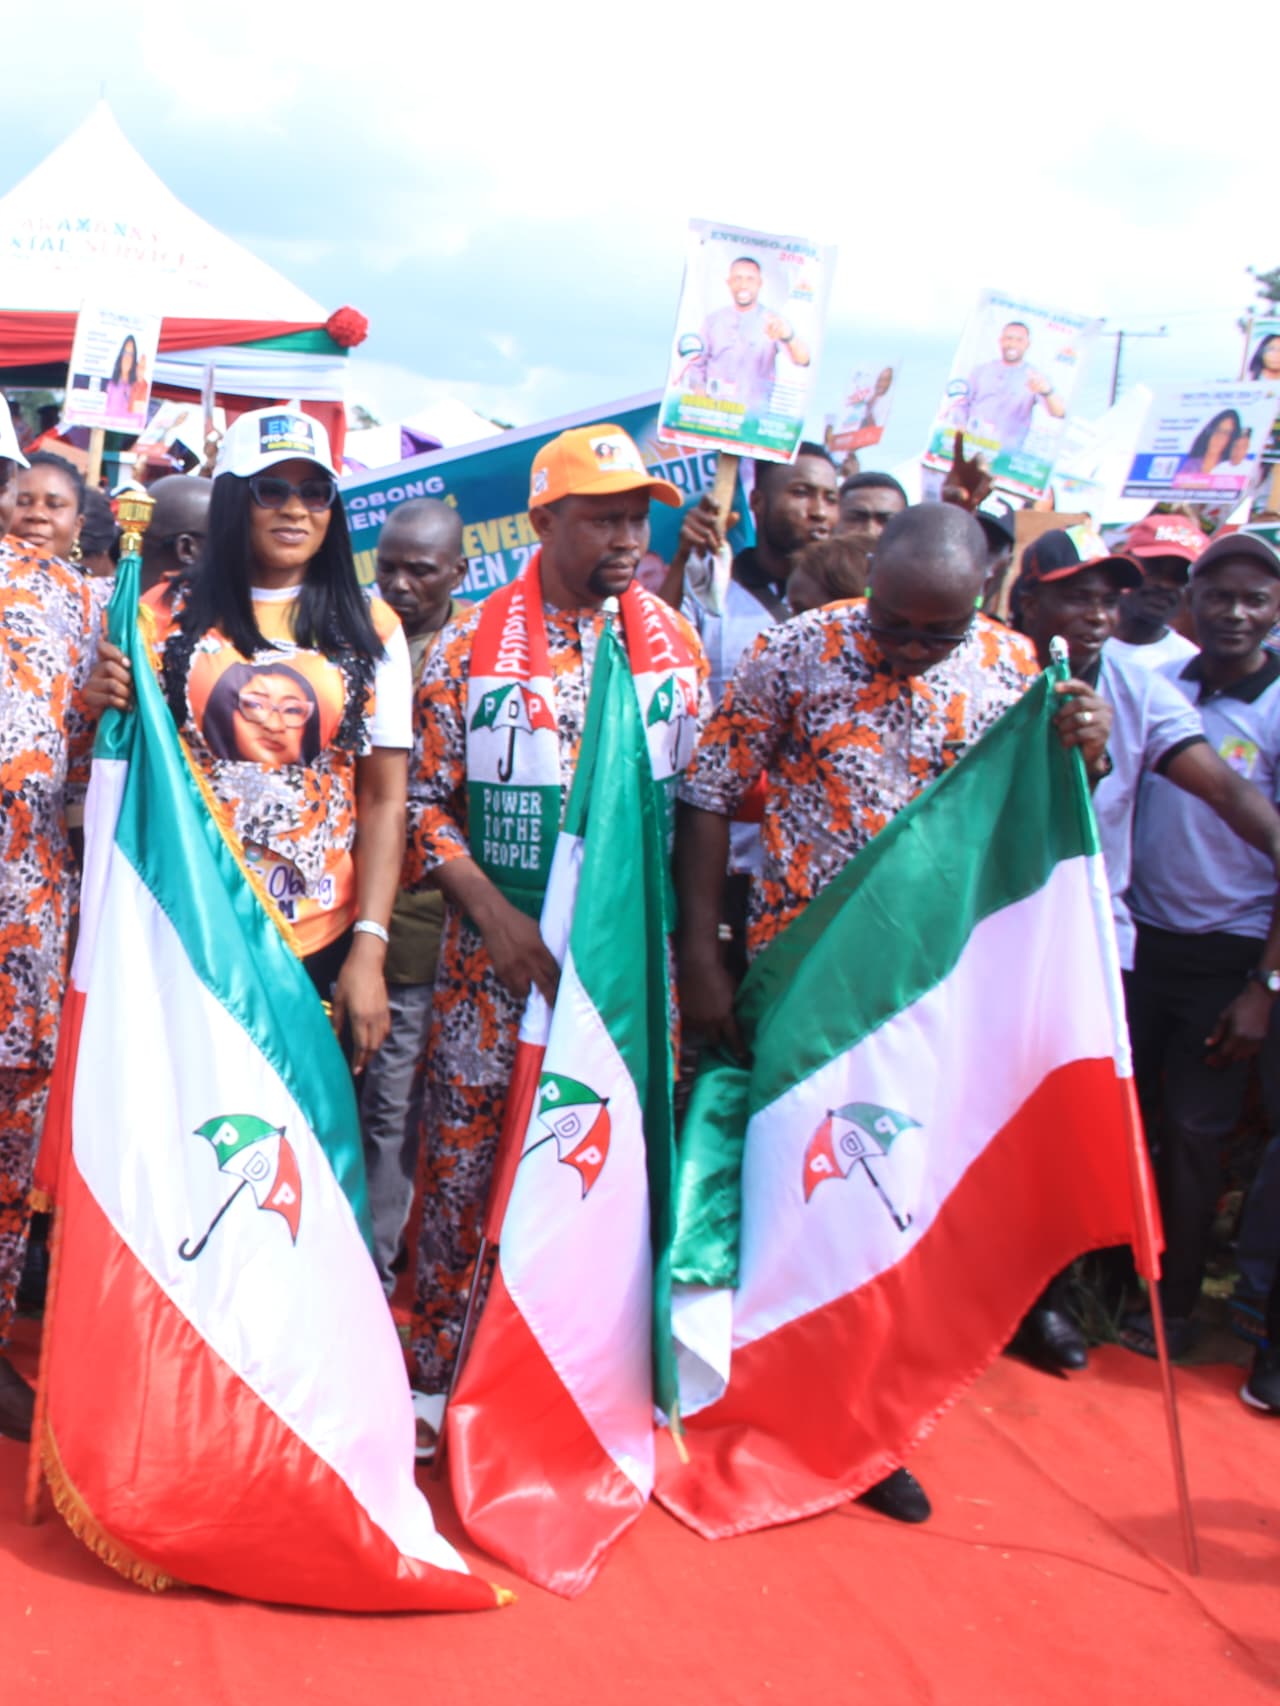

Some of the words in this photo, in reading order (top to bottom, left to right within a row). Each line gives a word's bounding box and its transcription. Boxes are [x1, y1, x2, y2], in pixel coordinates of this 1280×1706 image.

[484, 697, 543, 720] PDP
[484, 788, 543, 816] POWER
[484, 840, 540, 870] PEOPLE
[539, 1080, 603, 1165] PDP
[210, 1121, 297, 1206] PDP
